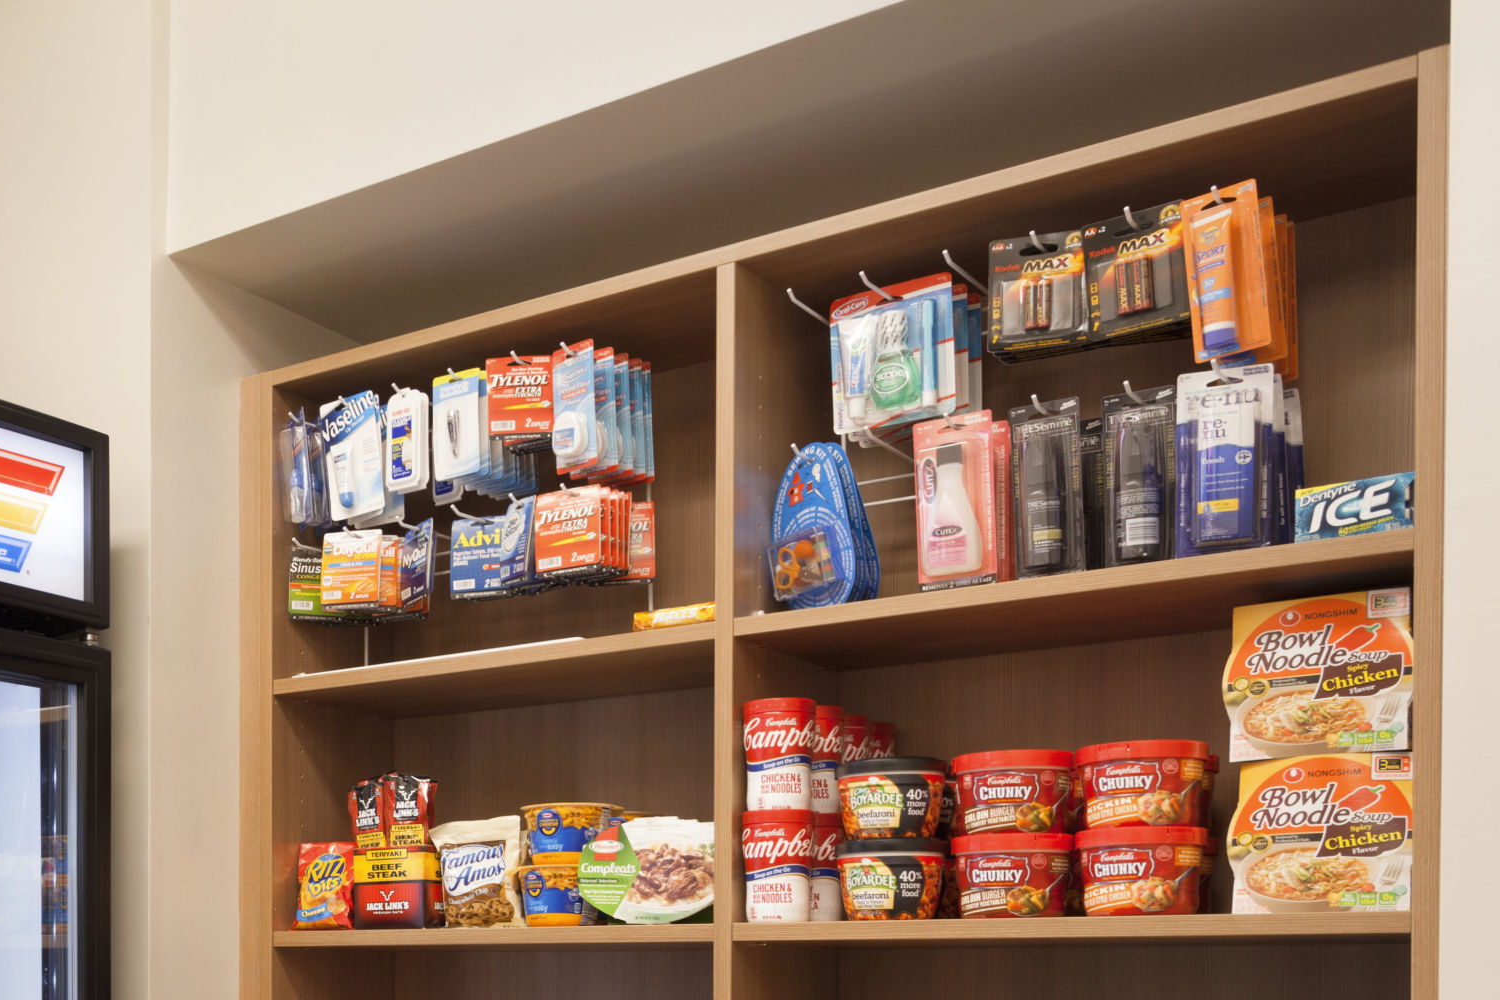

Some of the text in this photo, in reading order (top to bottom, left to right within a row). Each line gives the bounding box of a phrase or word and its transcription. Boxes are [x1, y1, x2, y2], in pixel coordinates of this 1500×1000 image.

[1089, 231, 1166, 258] Kodak MAX
[995, 254, 1070, 273] Kodak MAX
[490, 374, 549, 388] TYLENOL
[515, 386, 542, 394] EXTRA
[322, 390, 375, 443] Vaseline
[1300, 481, 1357, 508] Dentyne
[1309, 479, 1397, 533] ICE
[538, 505, 595, 526] TYLENOL
[562, 518, 588, 528] EXTRA
[935, 526, 960, 536] CUTEX
[453, 528, 503, 549] Advi
[290, 562, 321, 574] Sinus
[1304, 607, 1358, 620] NONGSHIM
[1255, 624, 1332, 652] Bowl
[1246, 646, 1387, 674] Noodle Soup
[1347, 663, 1368, 673] Spicy
[1322, 667, 1399, 692] Chicken
[1349, 684, 1375, 694] Flavor
[1105, 765, 1141, 776] Campbell's
[1308, 768, 1362, 778] NONGSHIM
[761, 773, 801, 783] CHICKEN &
[987, 774, 1021, 786] Campbell's
[1099, 775, 1153, 791] CHUNKY
[770, 783, 802, 794] NOODLES
[906, 788, 928, 800] 40%
[979, 785, 1033, 800] CHUNKY
[850, 793, 903, 809] BOYARDEE
[1260, 784, 1336, 809] Bowl
[396, 800, 416, 809] JACK
[358, 808, 376, 818] JACK
[393, 808, 419, 818] LINK'S
[857, 809, 896, 819] beefaroni
[907, 807, 926, 816] food
[989, 806, 1015, 817] BURGER
[356, 816, 380, 827] LINK'S
[1250, 805, 1391, 830] Noodle Soup
[1350, 824, 1372, 834] Spicy
[1324, 828, 1402, 852] Chicken
[548, 843, 563, 852] easy
[1352, 845, 1379, 854] Flavor
[443, 844, 504, 868] Famous
[1100, 851, 1136, 862] Campbell's
[372, 863, 402, 871] BEEF
[581, 862, 636, 876] Compleats
[978, 858, 1012, 869] Campbell's
[1095, 861, 1147, 876] CHUNKY
[307, 858, 345, 883] RITZ
[367, 870, 407, 878] STEAK
[899, 870, 923, 882] 40%
[972, 868, 1023, 883] CHUNKY
[449, 862, 505, 892] Amos
[846, 875, 896, 890] BOYARDEE
[309, 877, 342, 896] bits
[753, 883, 792, 893] CHICKEN &
[761, 893, 793, 904] NOODLES
[852, 891, 890, 901] beefaroni
[902, 889, 920, 897] food
[982, 889, 1006, 900] BURGER
[366, 901, 409, 911] JACK LINK'S
[301, 907, 326, 918] Cheese
